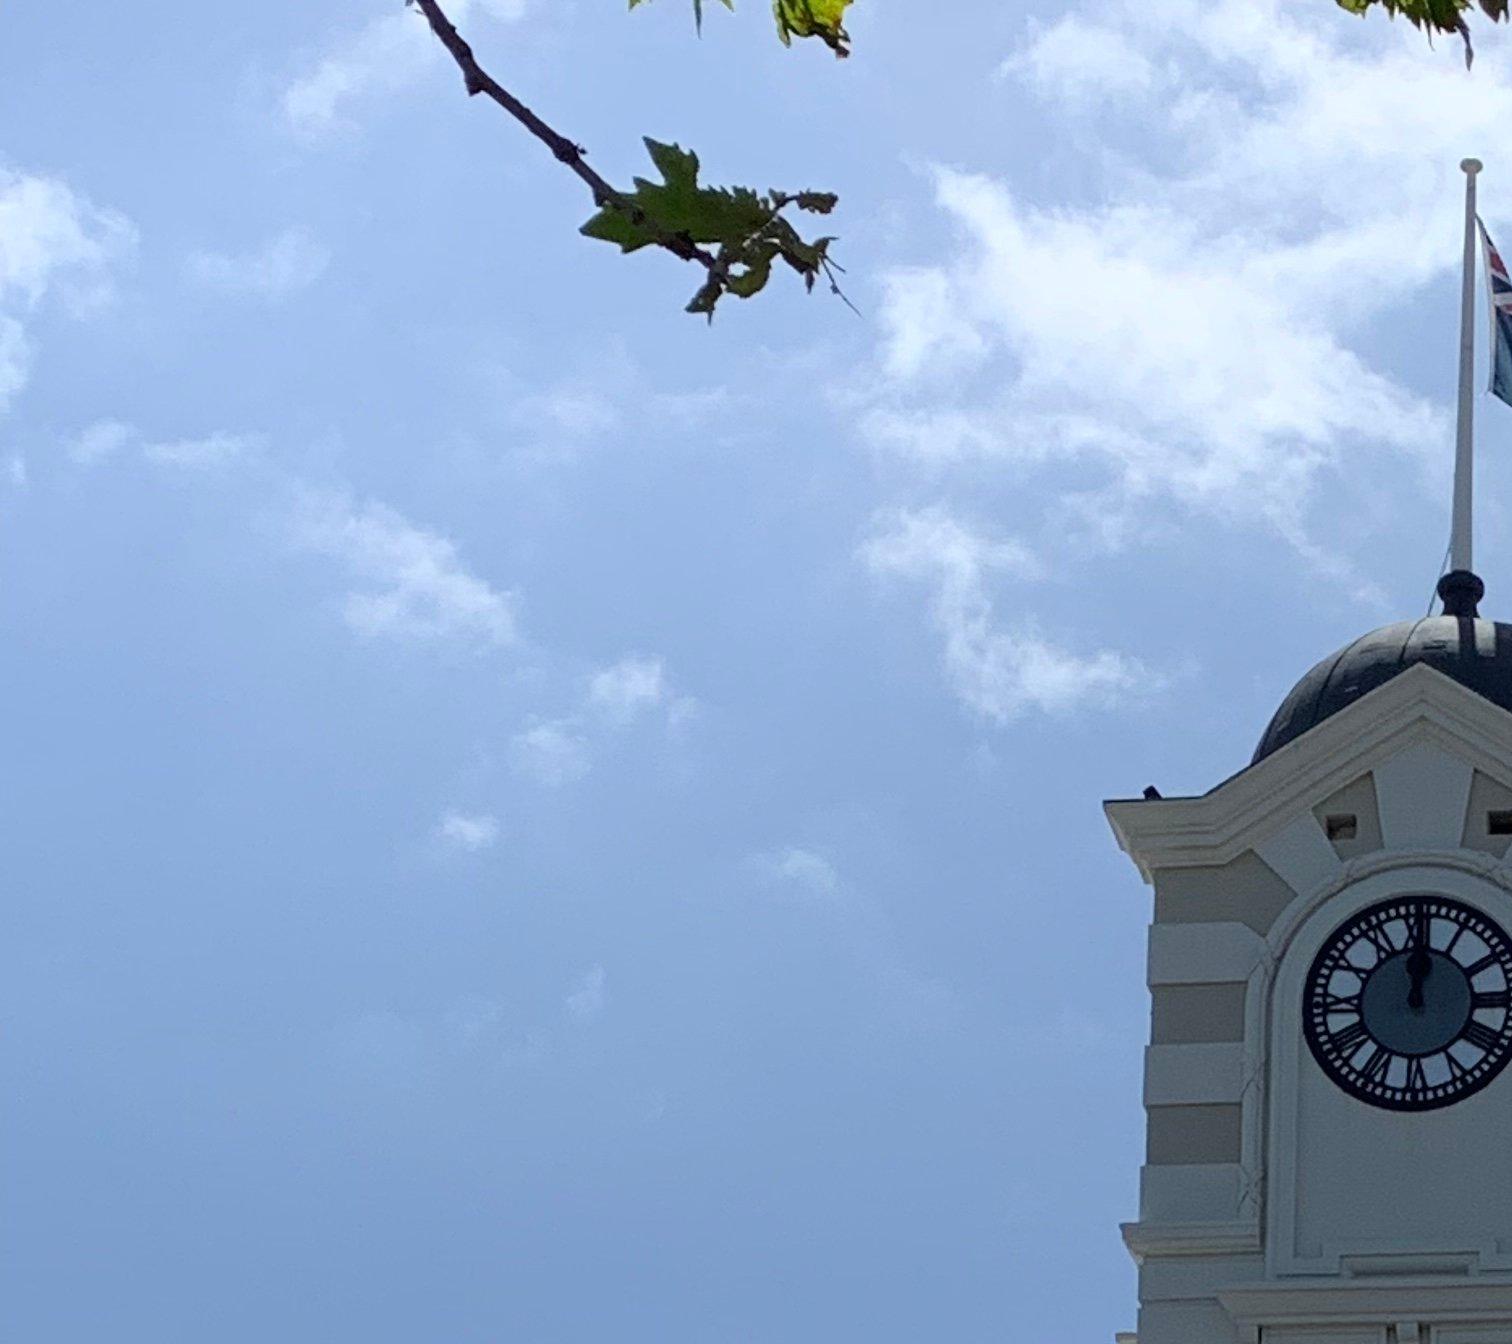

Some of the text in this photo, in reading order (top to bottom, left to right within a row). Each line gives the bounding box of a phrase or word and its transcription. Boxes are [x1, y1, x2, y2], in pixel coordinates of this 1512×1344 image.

[1446, 924, 1465, 953] I
[1464, 952, 1497, 975] II
[1470, 991, 1509, 1008] III
